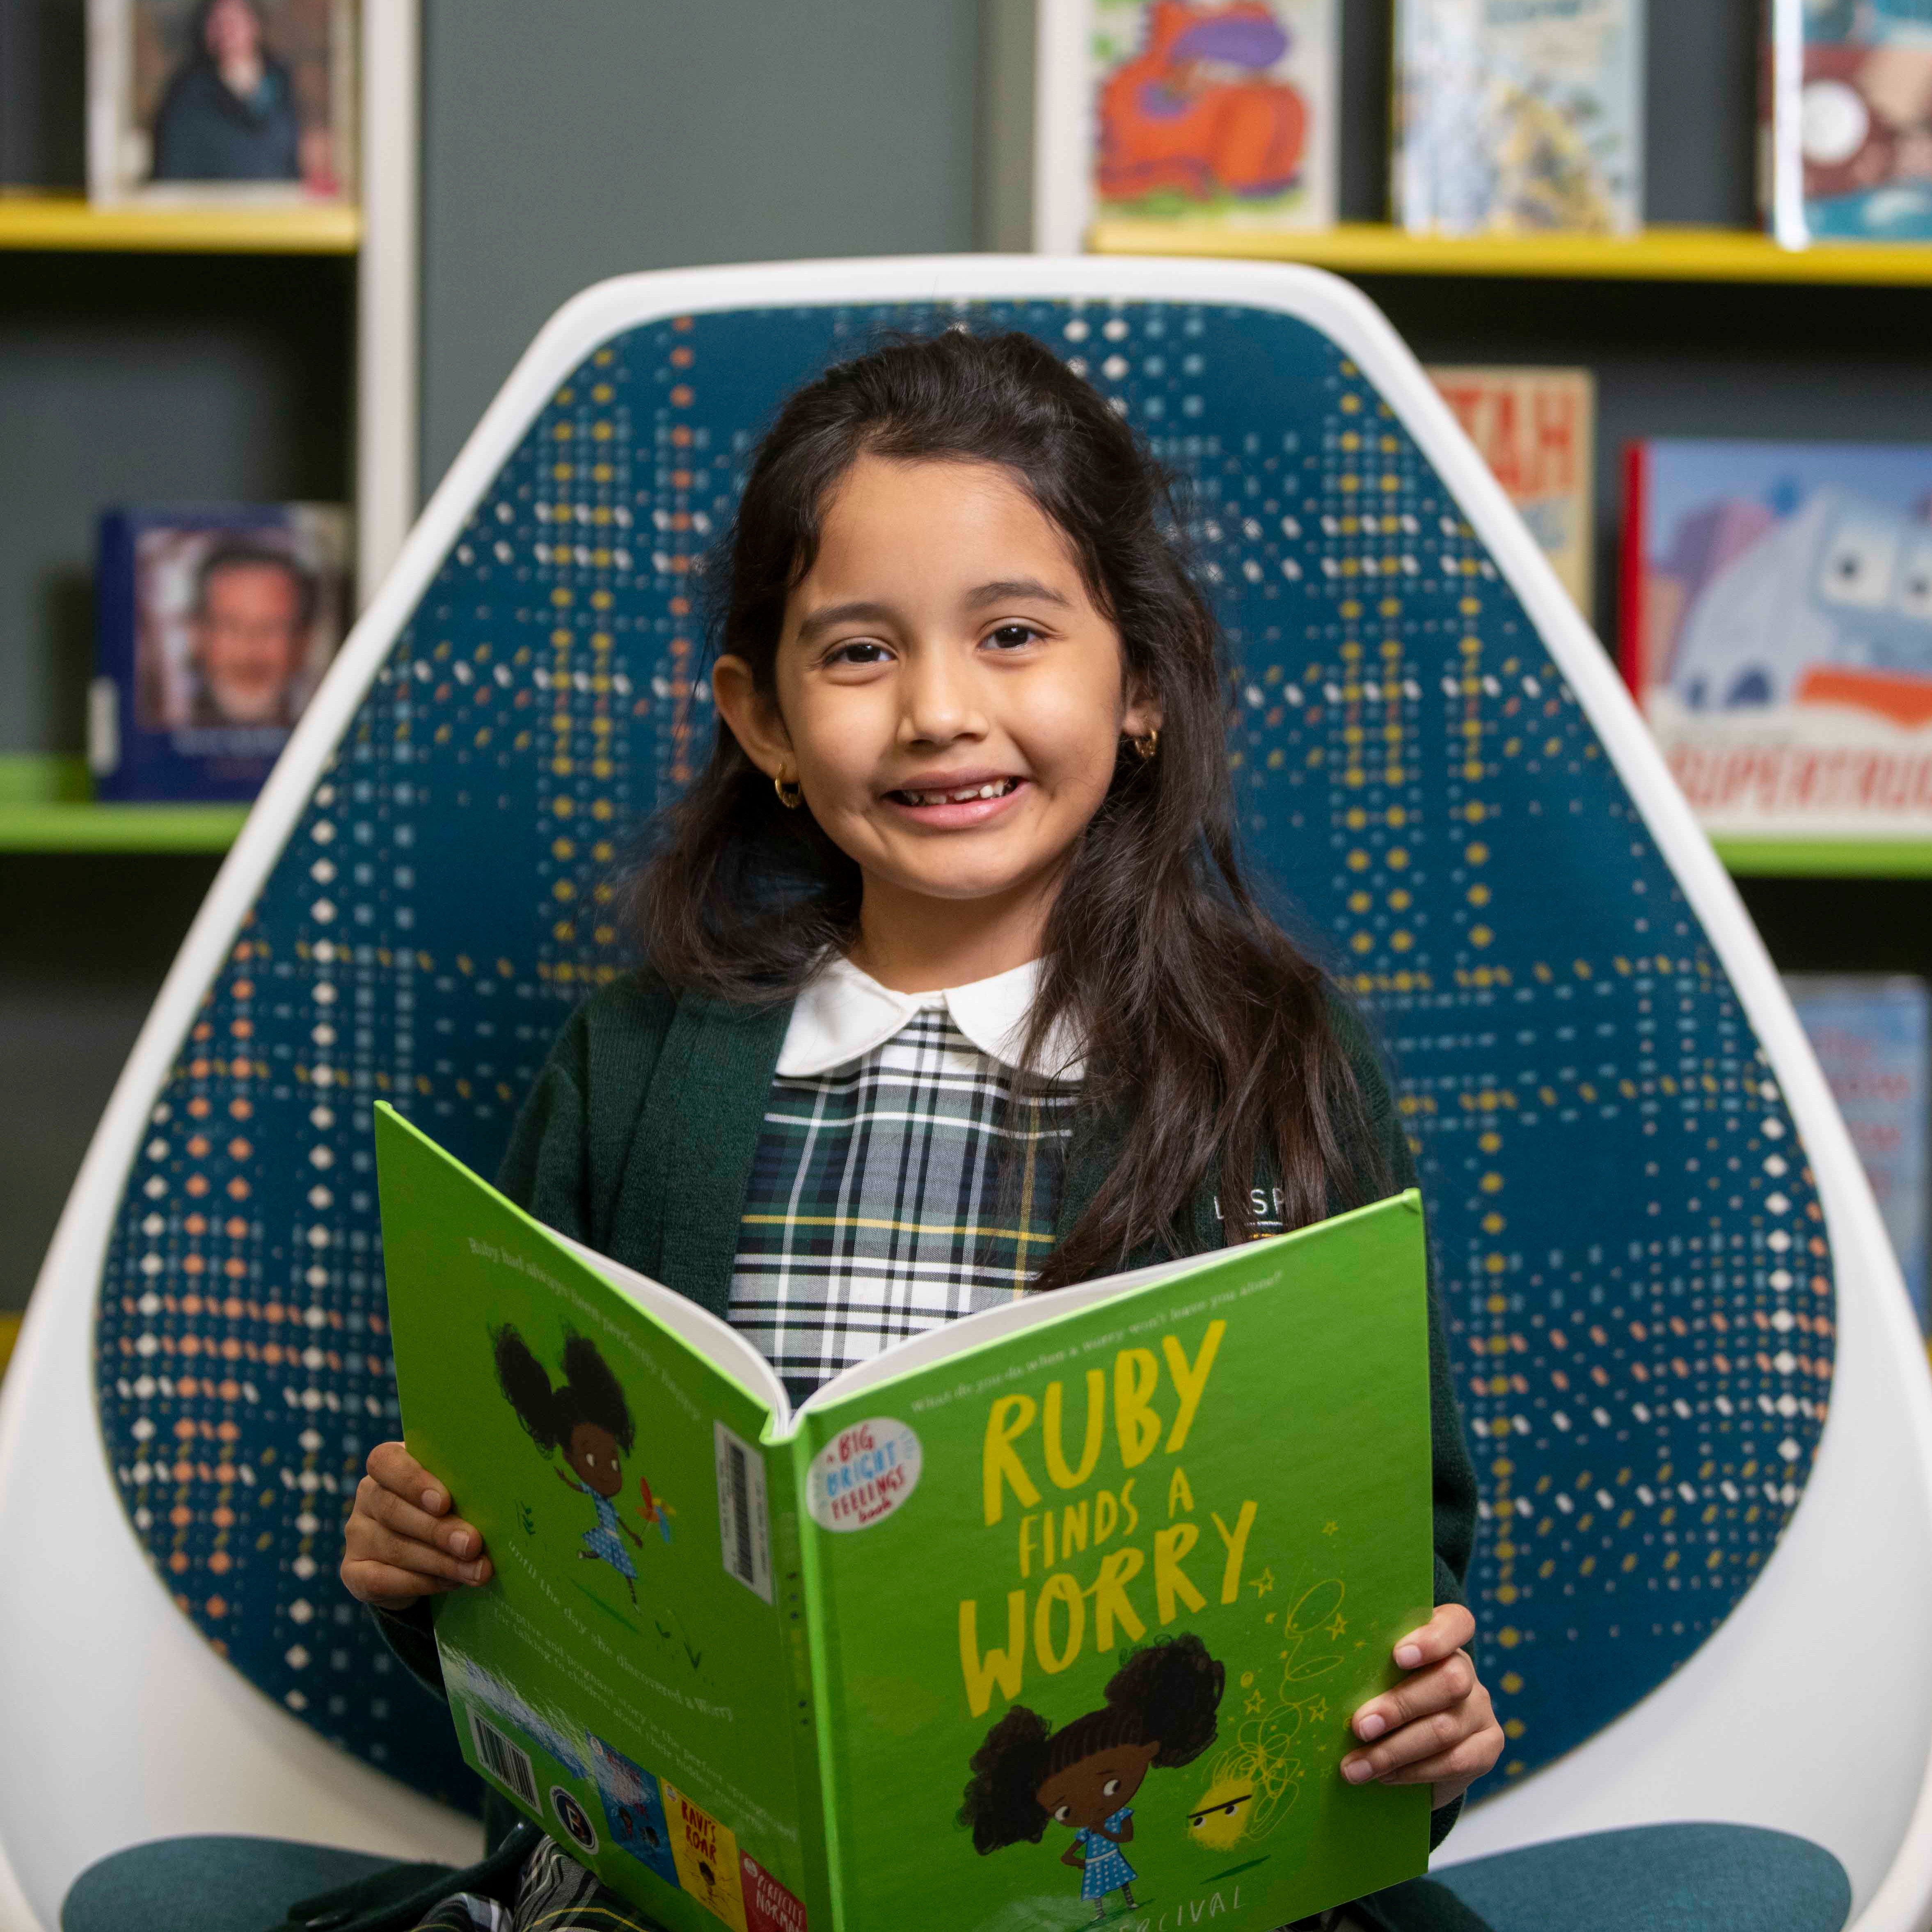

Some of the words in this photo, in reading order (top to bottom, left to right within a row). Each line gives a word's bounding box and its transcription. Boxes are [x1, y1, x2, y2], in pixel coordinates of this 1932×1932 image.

[911, 1390, 952, 1414] What
[954, 1383, 973, 1399] do
[975, 1376, 1004, 1395] you
[1026, 1351, 1066, 1373] when
[1082, 1330, 1125, 1351] worry
[1170, 1300, 1208, 1322] leave
[1210, 1290, 1237, 1310] you
[1239, 1269, 1284, 1297] alone?
[839, 1423, 874, 1463] BIG
[982, 1319, 1227, 1527] RUBY
[827, 1440, 895, 1498] BRIGHT
[831, 1464, 905, 1521] FEELINGS
[1019, 1477, 1140, 1578] FINDS
[1168, 1467, 1194, 1519] A
[508, 1540, 537, 1579] until
[540, 1578, 561, 1607] the
[563, 1607, 588, 1634] day
[616, 1652, 683, 1705] discovered
[958, 1500, 1258, 1719] WORRY
[681, 1799, 716, 1843] RAVI'S
[685, 1824, 716, 1865] ROAR
